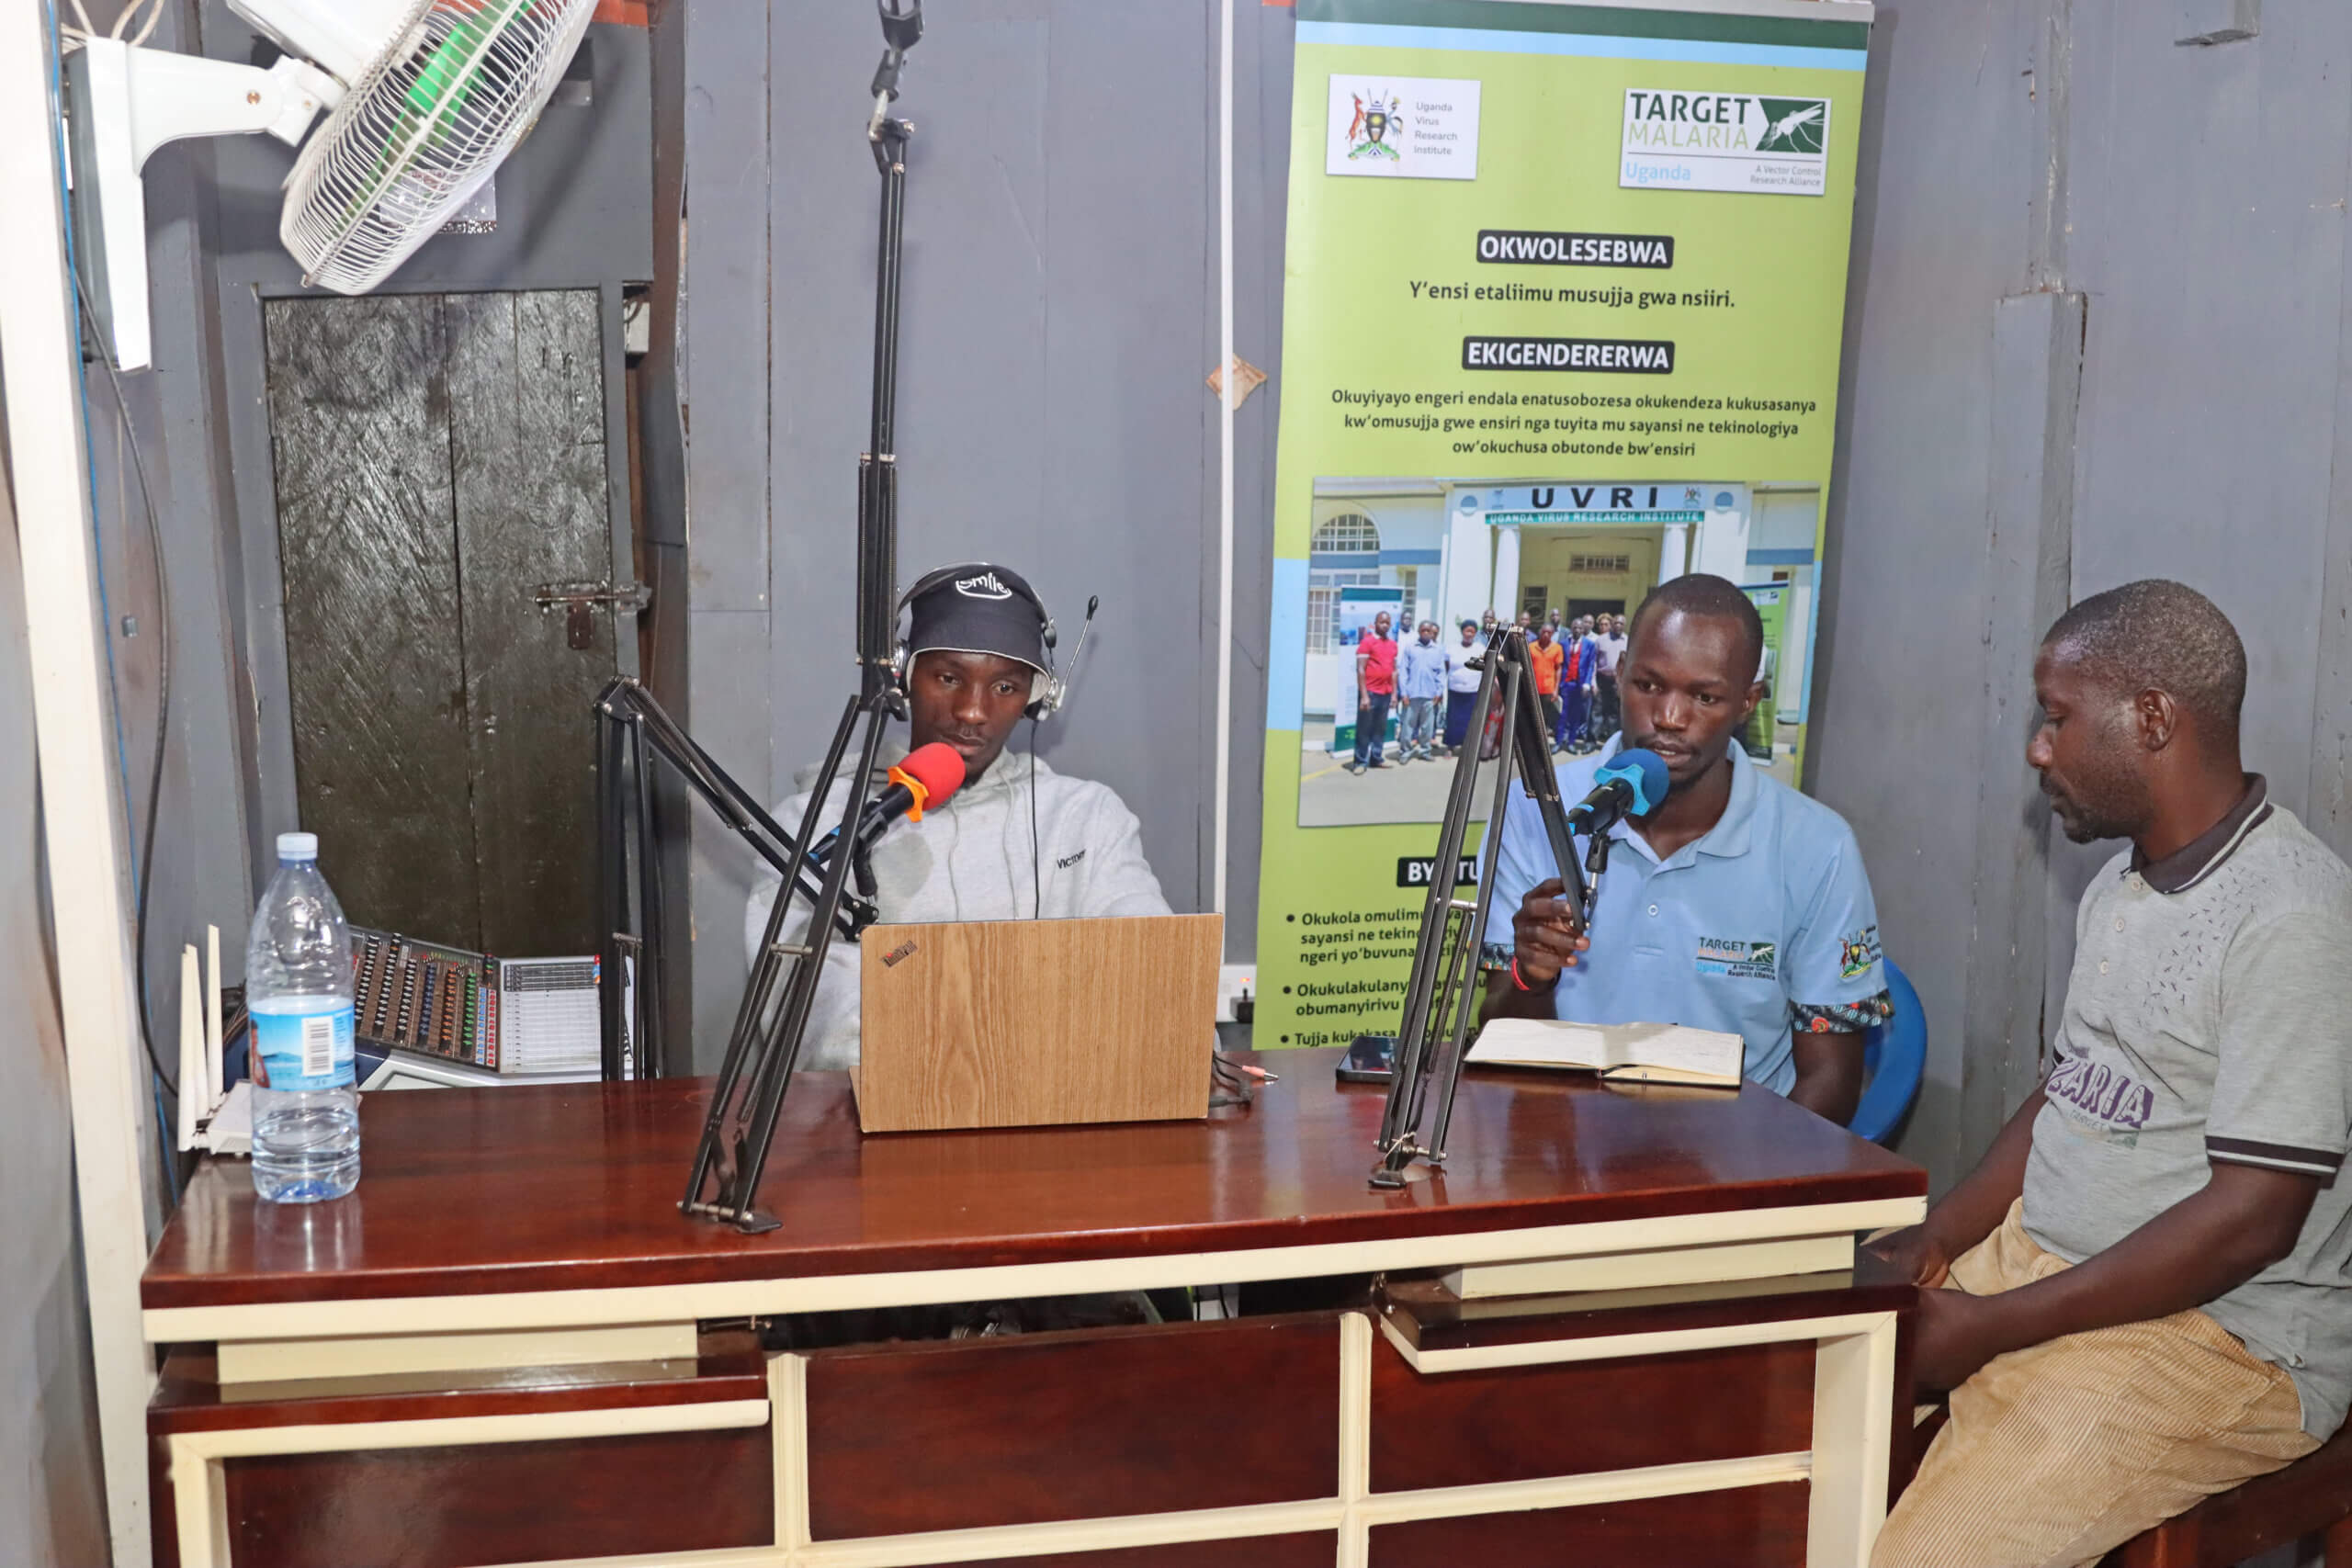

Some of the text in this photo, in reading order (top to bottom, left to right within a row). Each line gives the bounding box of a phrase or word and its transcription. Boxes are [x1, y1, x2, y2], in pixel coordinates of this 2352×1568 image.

[1416, 102, 1453, 112] Uganda
[1630, 93, 1751, 125] TARGET
[1416, 117, 1439, 126] Virus
[1415, 130, 1457, 141] Research
[1627, 122, 1749, 150] MALARIA
[1414, 145, 1452, 155] Institute
[1625, 161, 1691, 184] Uganda
[1763, 166, 1790, 175] Vector
[1792, 166, 1821, 176] Control
[1750, 175, 1821, 186] Research Alliance
[1480, 236, 1668, 265] OKWOLESEBWA
[1475, 285, 1553, 301] etaliimu
[1559, 287, 1633, 308] musujja
[1638, 292, 1677, 310] gwa
[1682, 289, 1736, 308] nsiiri.
[1468, 342, 1669, 368] EKIGENDERERWA
[1331, 389, 1816, 415] Okuyiyayo engeri endala enatusobozesa okukendeza kukusasanya
[1443, 417, 1475, 432] gwe
[1479, 415, 1521, 430] ensiri
[1524, 418, 1550, 433] nga
[1555, 416, 1597, 434] tuyita
[1602, 419, 1625, 432] mu
[1629, 419, 1683, 436] sayansi
[1687, 421, 1704, 433] ne
[1709, 420, 1799, 438] tekinologiya
[1552, 440, 1623, 456] obutonde
[1489, 511, 1699, 523] UGANDA VIRUS RESEARCH INSTITUTE
[1408, 862, 1477, 882] BYTU
[1302, 910, 1361, 926] Okukola
[1301, 928, 1353, 947] sayansi
[1357, 930, 1374, 942] ne
[1699, 937, 1746, 952] TARGET
[1300, 946, 1338, 965] ngeri
[1296, 998, 1399, 1016] obumanyirivu
[1295, 1032, 1329, 1047] Tujja
